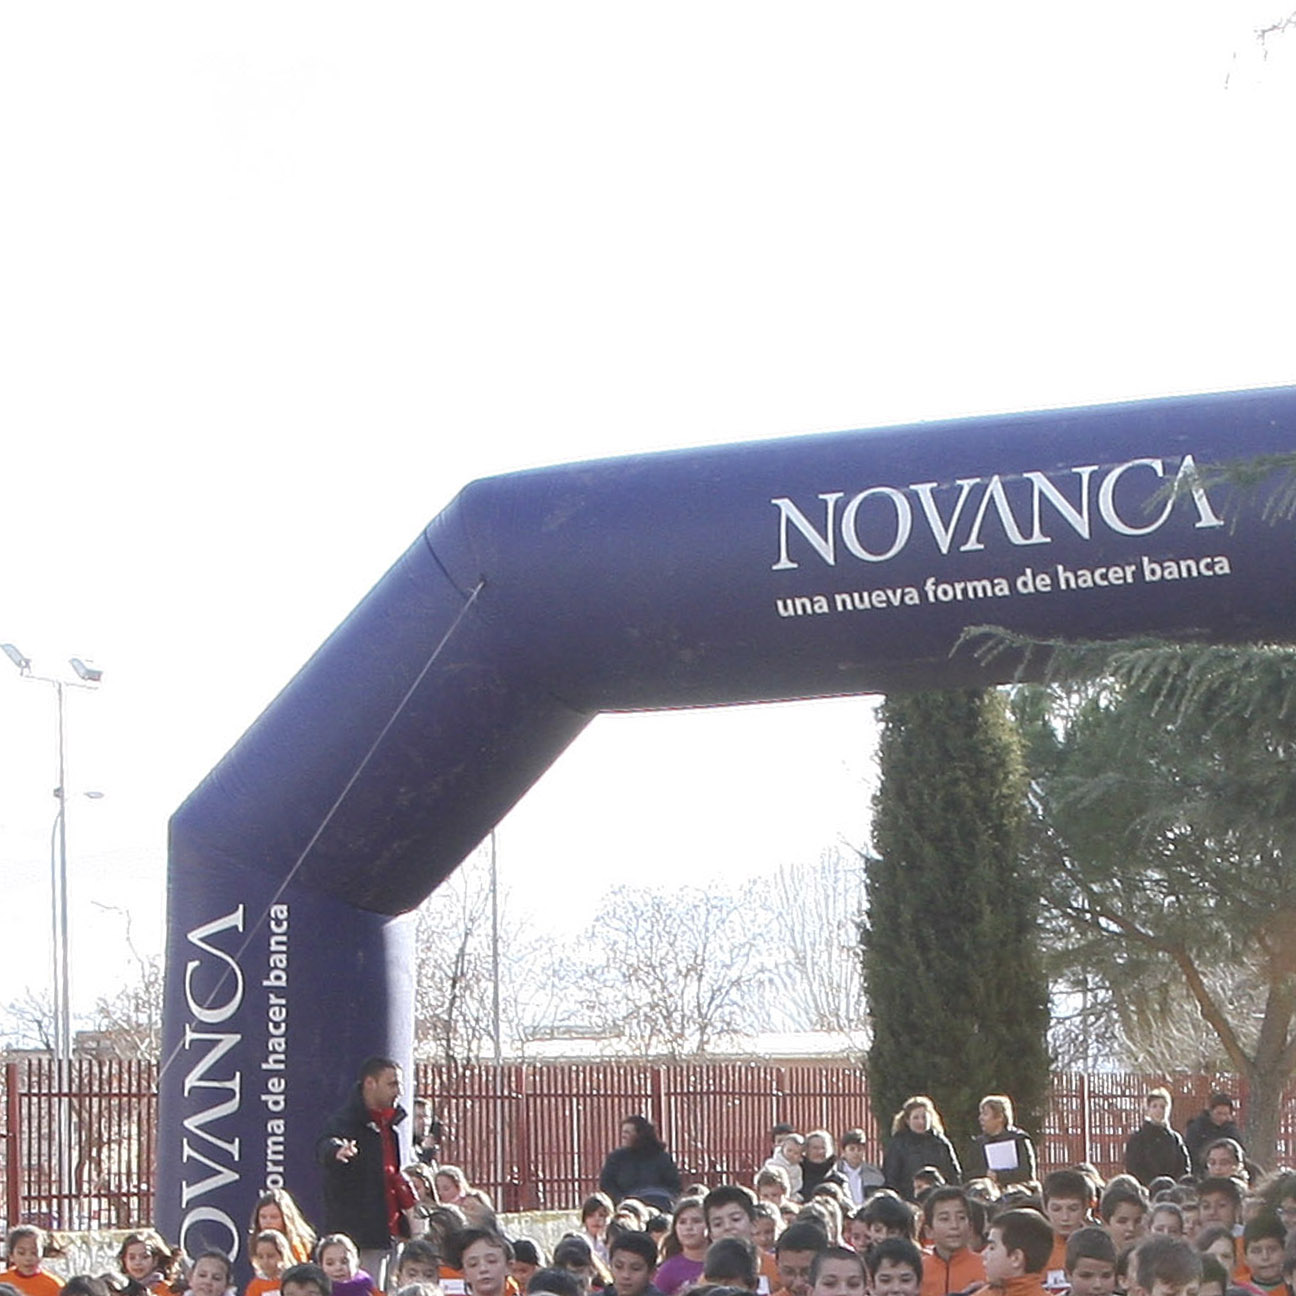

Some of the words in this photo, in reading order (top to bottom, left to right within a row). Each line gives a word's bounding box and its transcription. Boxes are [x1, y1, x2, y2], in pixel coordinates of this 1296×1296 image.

[771, 454, 1224, 571] NOVANCA
[776, 595, 830, 617] una
[834, 586, 921, 612] nueva
[924, 577, 1010, 602] forma
[1016, 568, 1052, 594] de
[1056, 564, 1136, 590] hacer
[1141, 555, 1232, 582] banca
[262, 904, 289, 987] banca
[261, 993, 287, 1070] hacer
[180, 903, 244, 1268] OVANCA
[261, 1076, 286, 1112] de
[259, 1118, 285, 1198] orma
